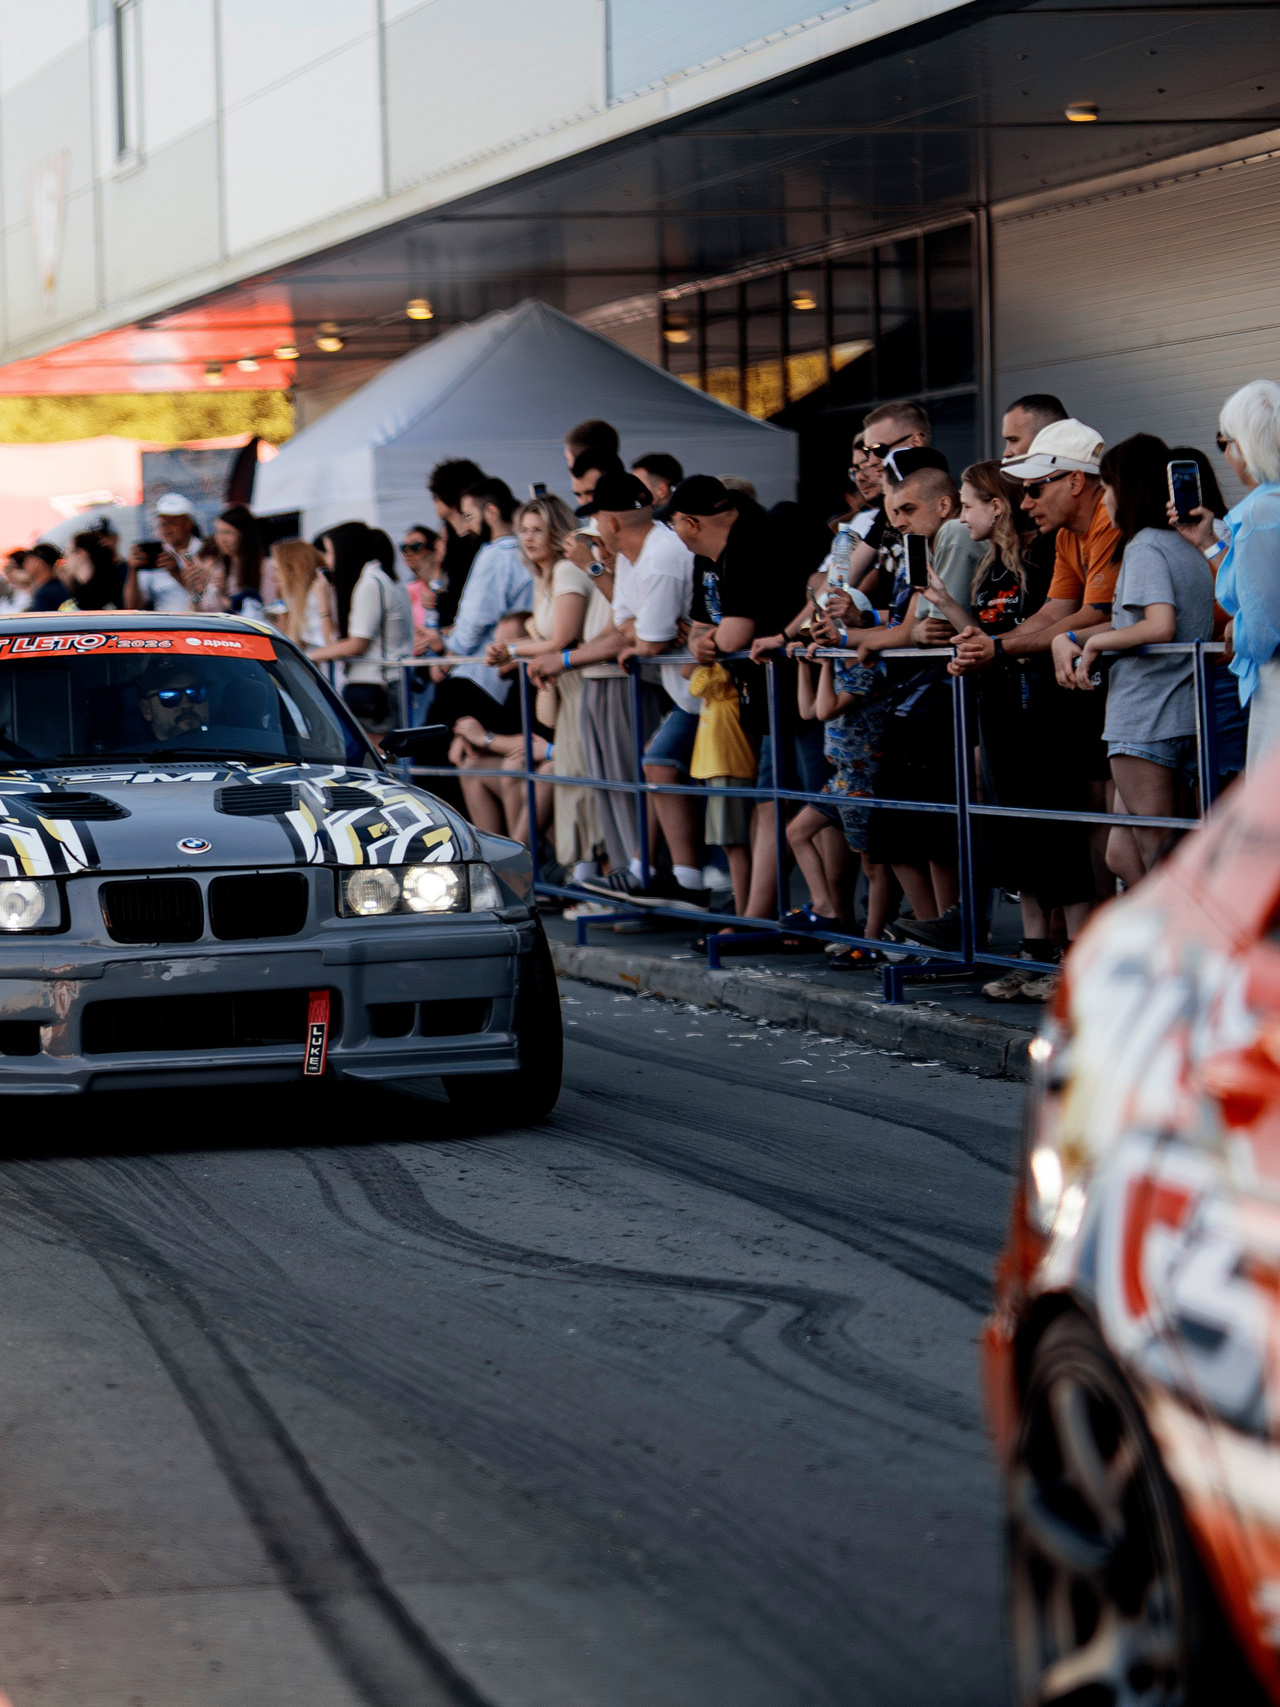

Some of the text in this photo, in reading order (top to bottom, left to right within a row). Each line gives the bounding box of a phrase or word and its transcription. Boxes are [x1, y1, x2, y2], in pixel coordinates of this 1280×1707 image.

[12, 633, 107, 653] LETO
[116, 639, 173, 649] 2026
[309, 1026, 322, 1065] LUKE
